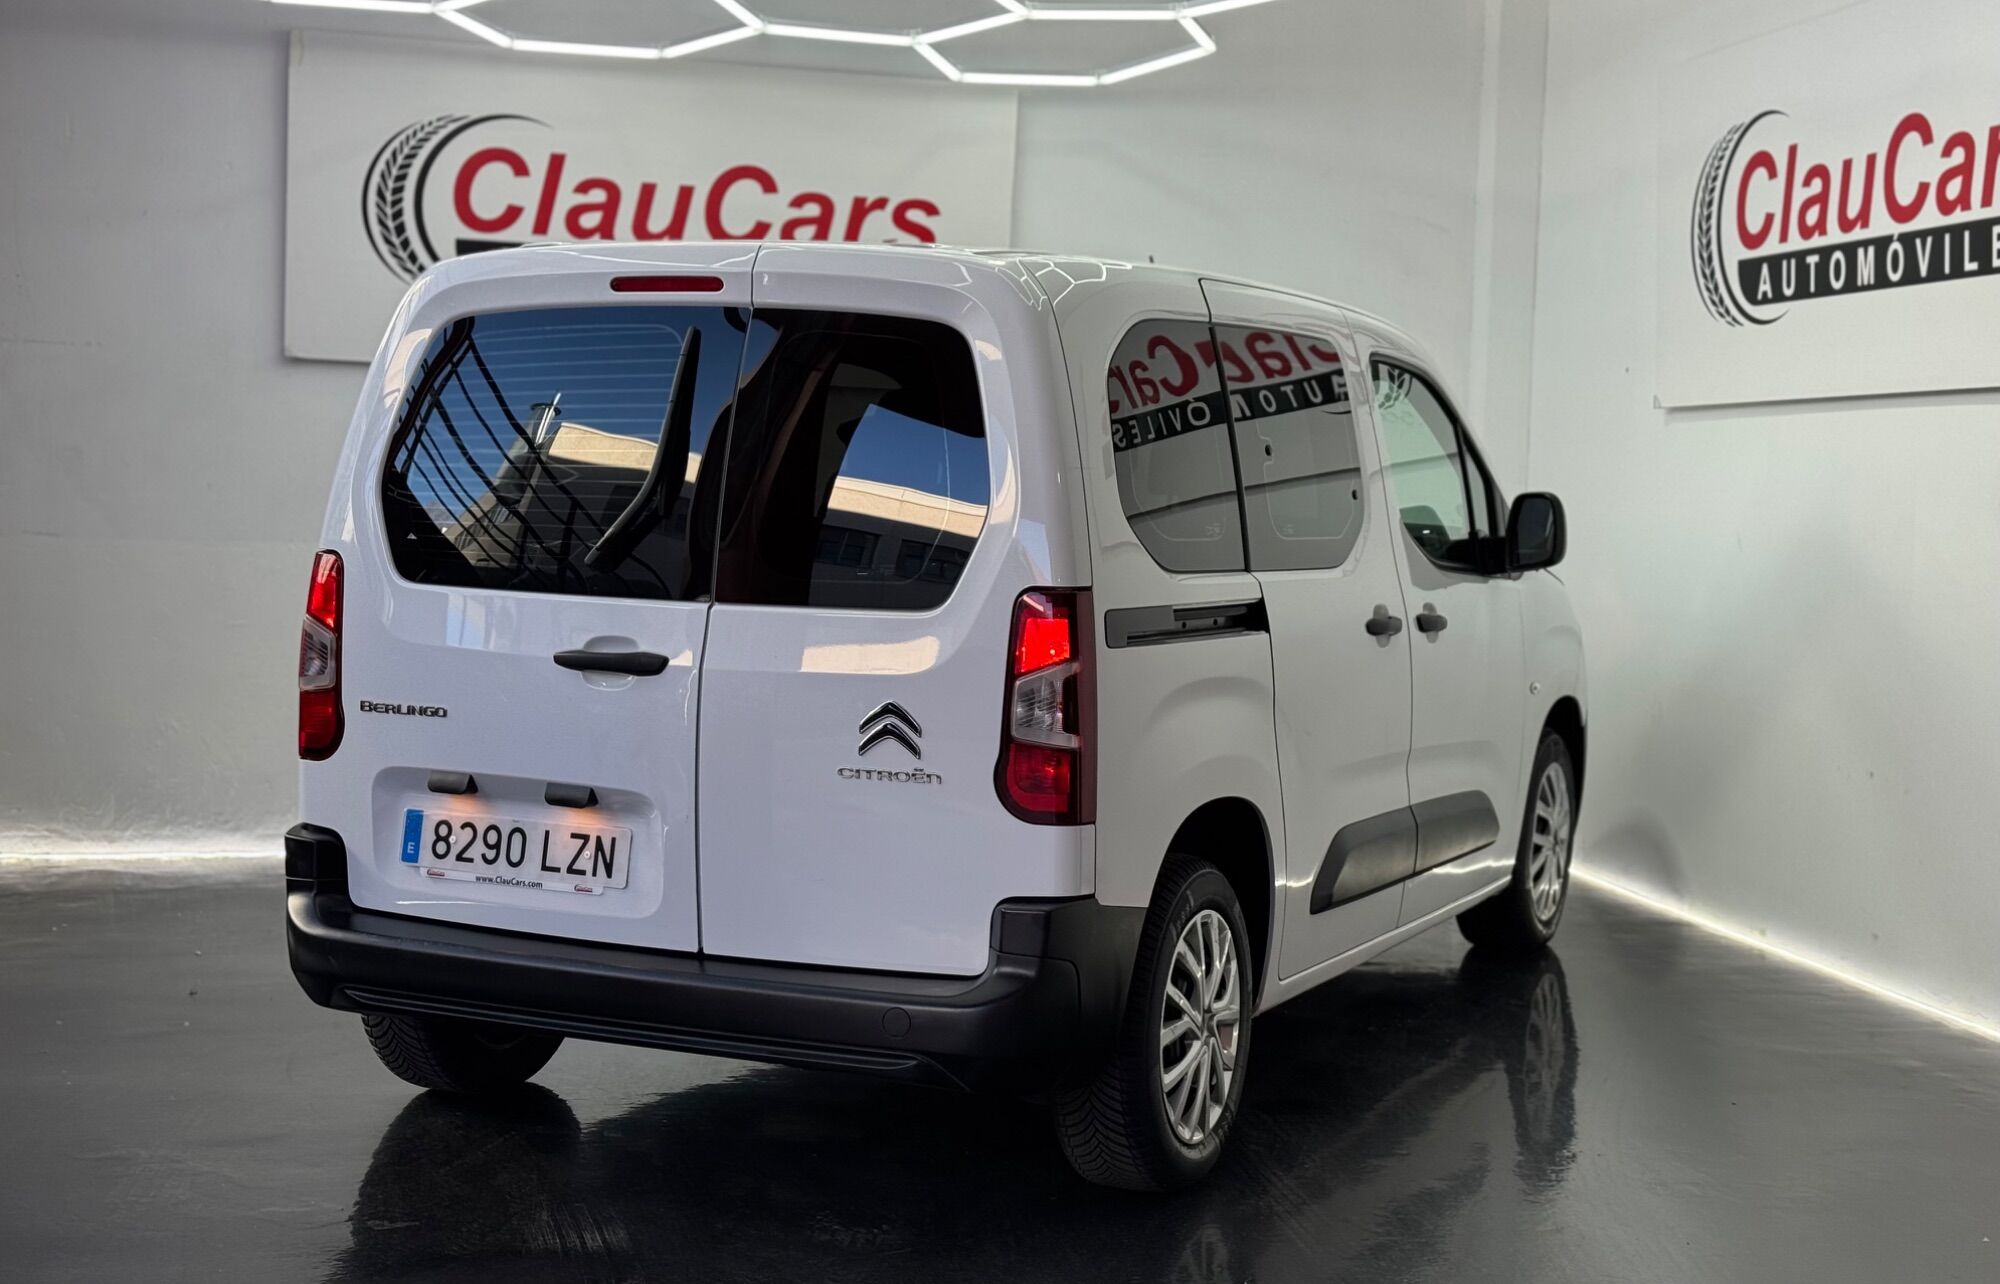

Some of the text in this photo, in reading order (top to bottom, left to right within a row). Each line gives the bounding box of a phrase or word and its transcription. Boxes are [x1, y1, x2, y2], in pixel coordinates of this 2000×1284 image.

[453, 147, 942, 243] ClauCars
[360, 700, 448, 718] BERLINGO
[406, 841, 416, 854] E
[431, 819, 617, 879] 8290 LZN
[475, 874, 543, 889] www.ClauCars.com
